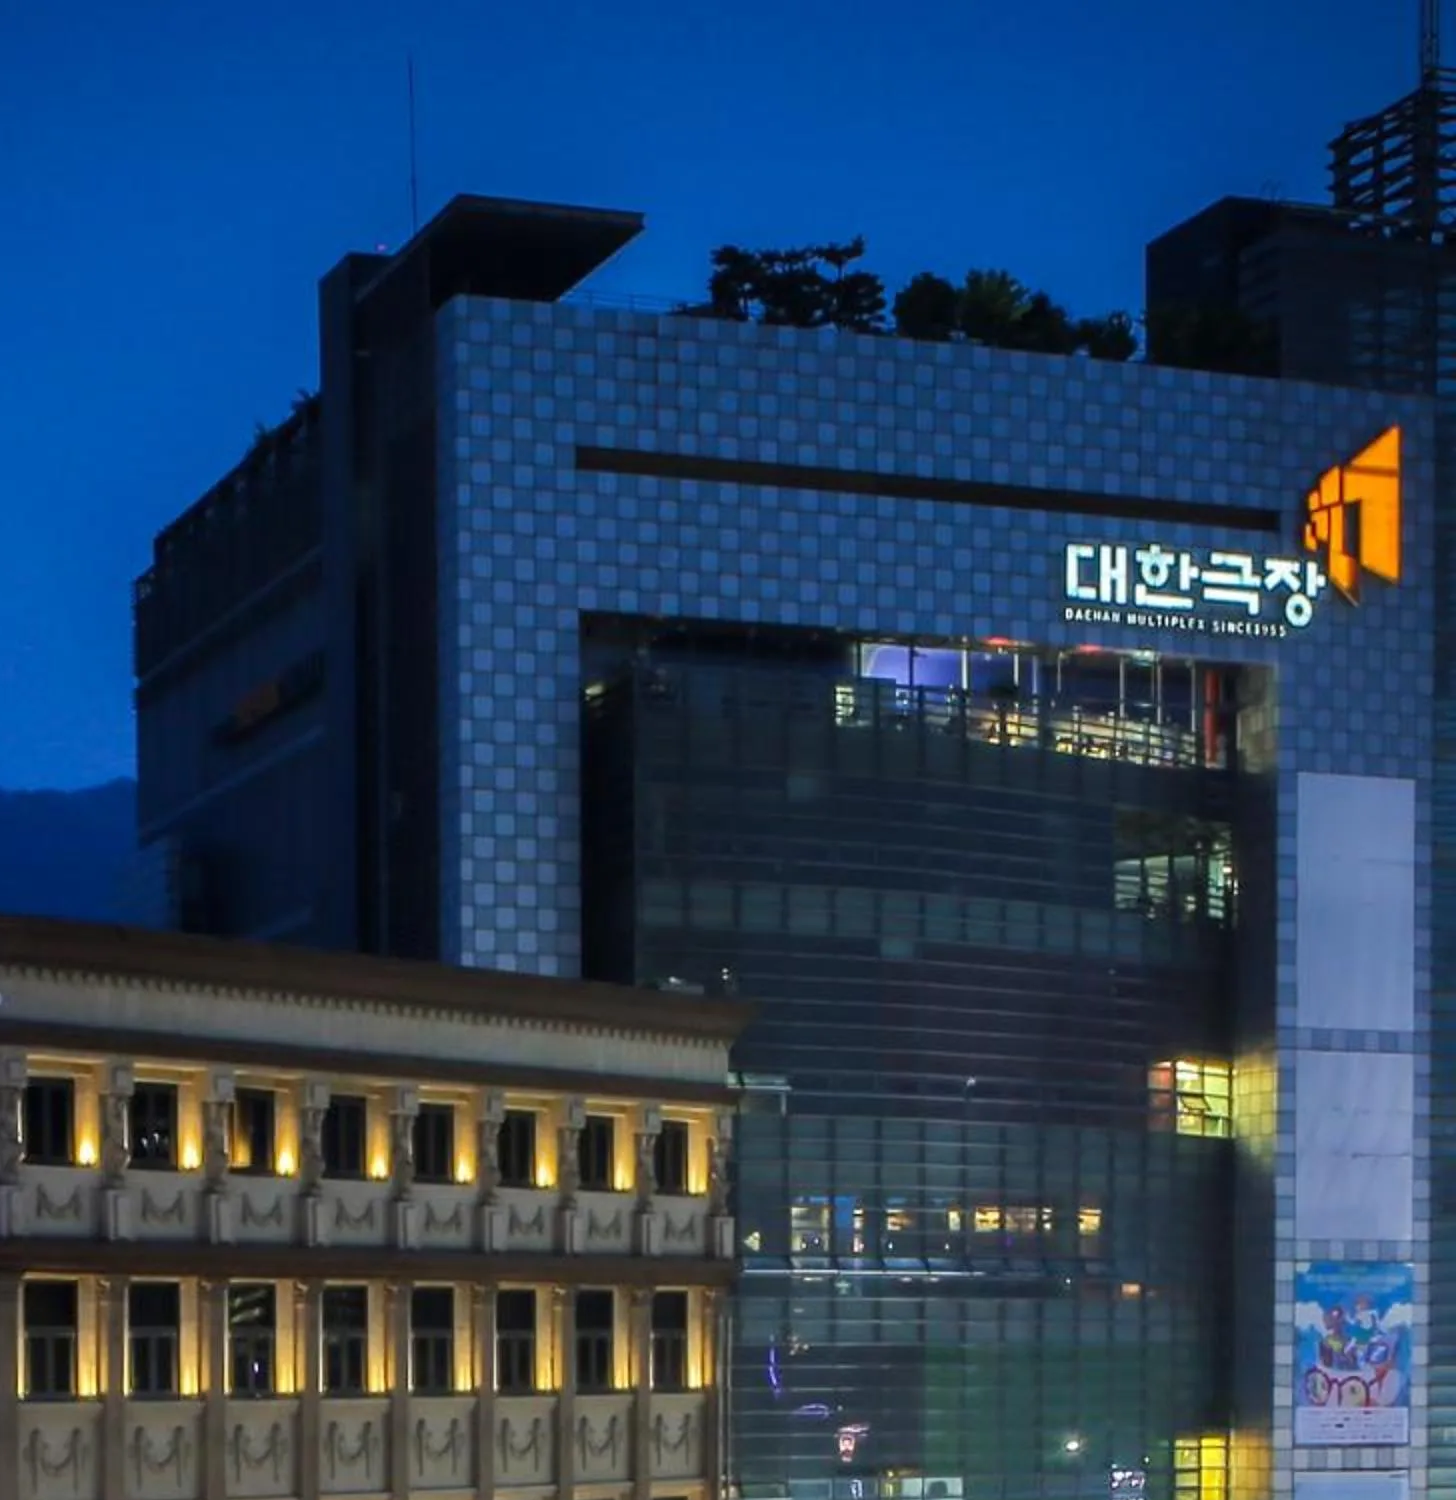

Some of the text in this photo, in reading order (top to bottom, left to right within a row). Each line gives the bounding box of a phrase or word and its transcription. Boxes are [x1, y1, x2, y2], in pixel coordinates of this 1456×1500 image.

[1065, 543, 1327, 628] 대한극장
[1065, 607, 1121, 623] DAEHAN
[1127, 612, 1205, 631] MULTIPLEX
